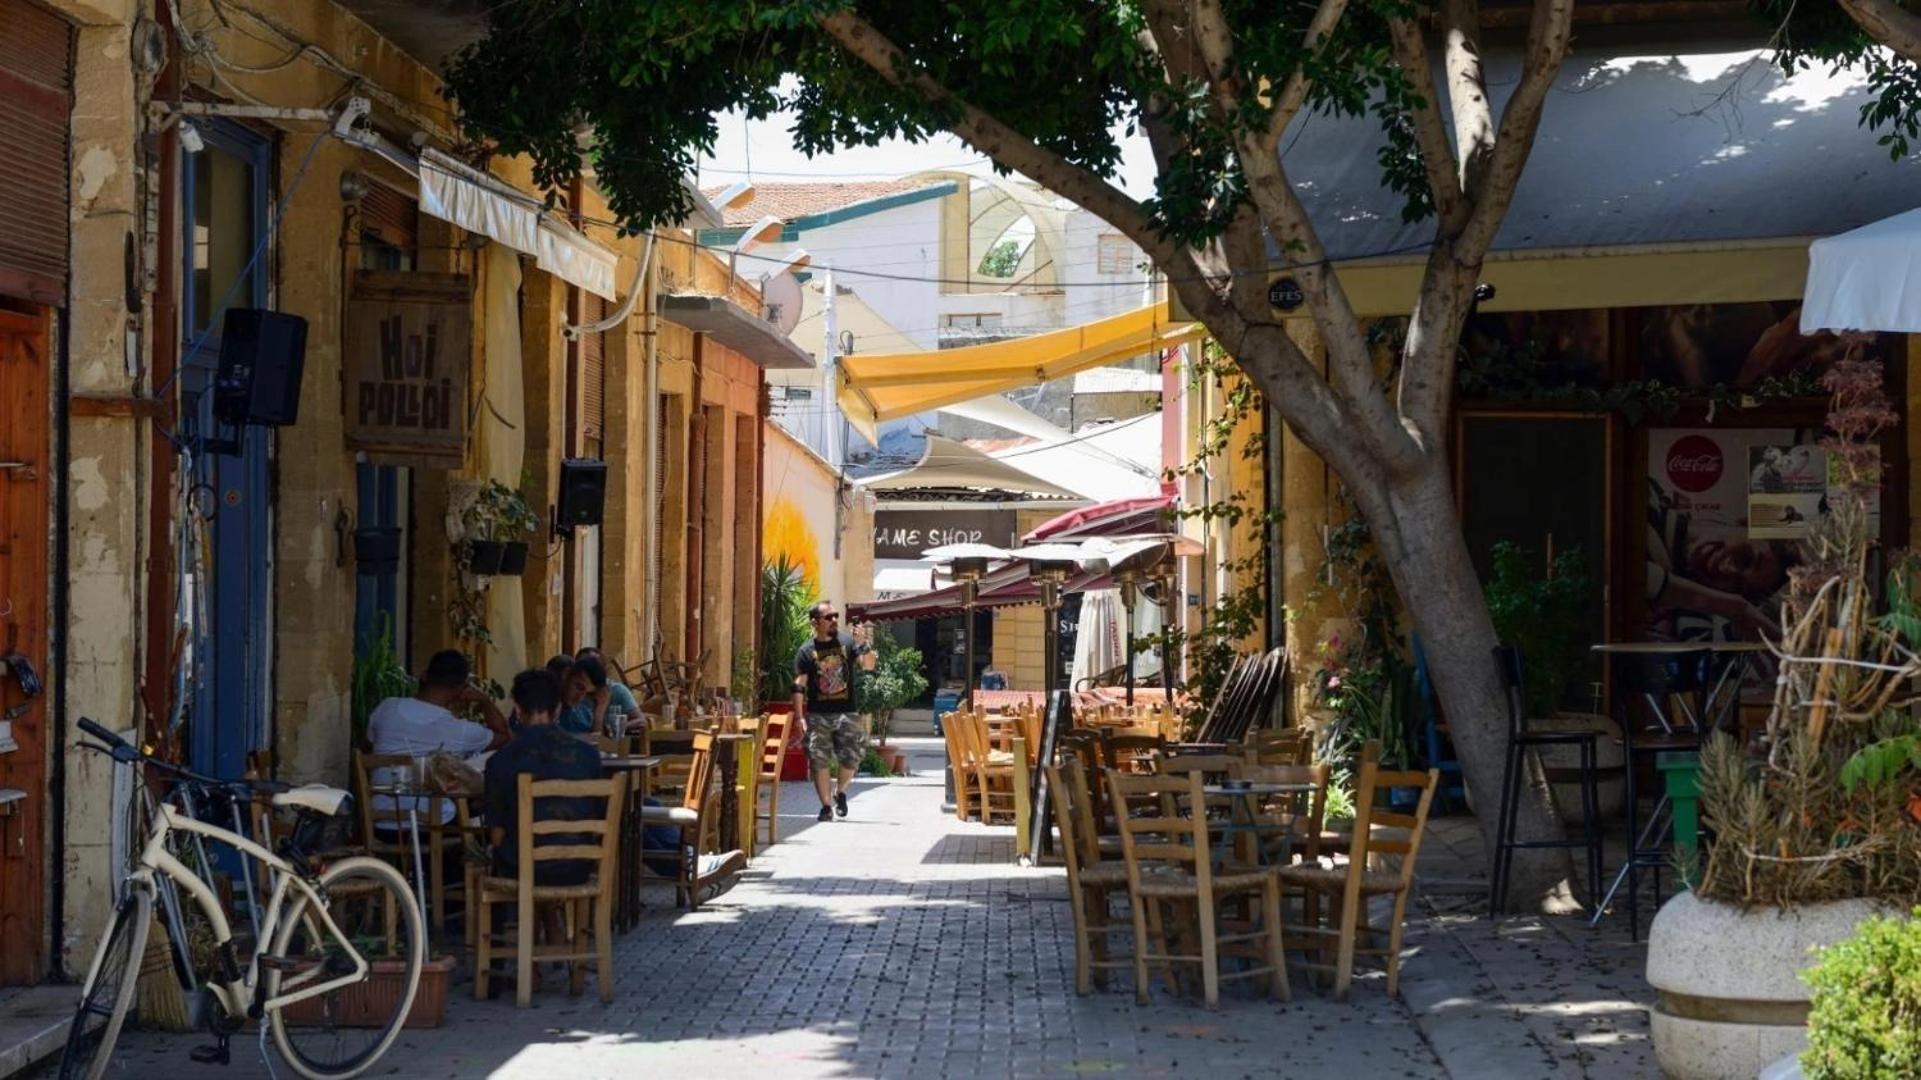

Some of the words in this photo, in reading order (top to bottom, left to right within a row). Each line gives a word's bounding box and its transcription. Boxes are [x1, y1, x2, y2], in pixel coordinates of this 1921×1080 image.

[1271, 291, 1302, 302] EFES
[873, 527, 921, 548] AME
[928, 528, 983, 546] SHOP
